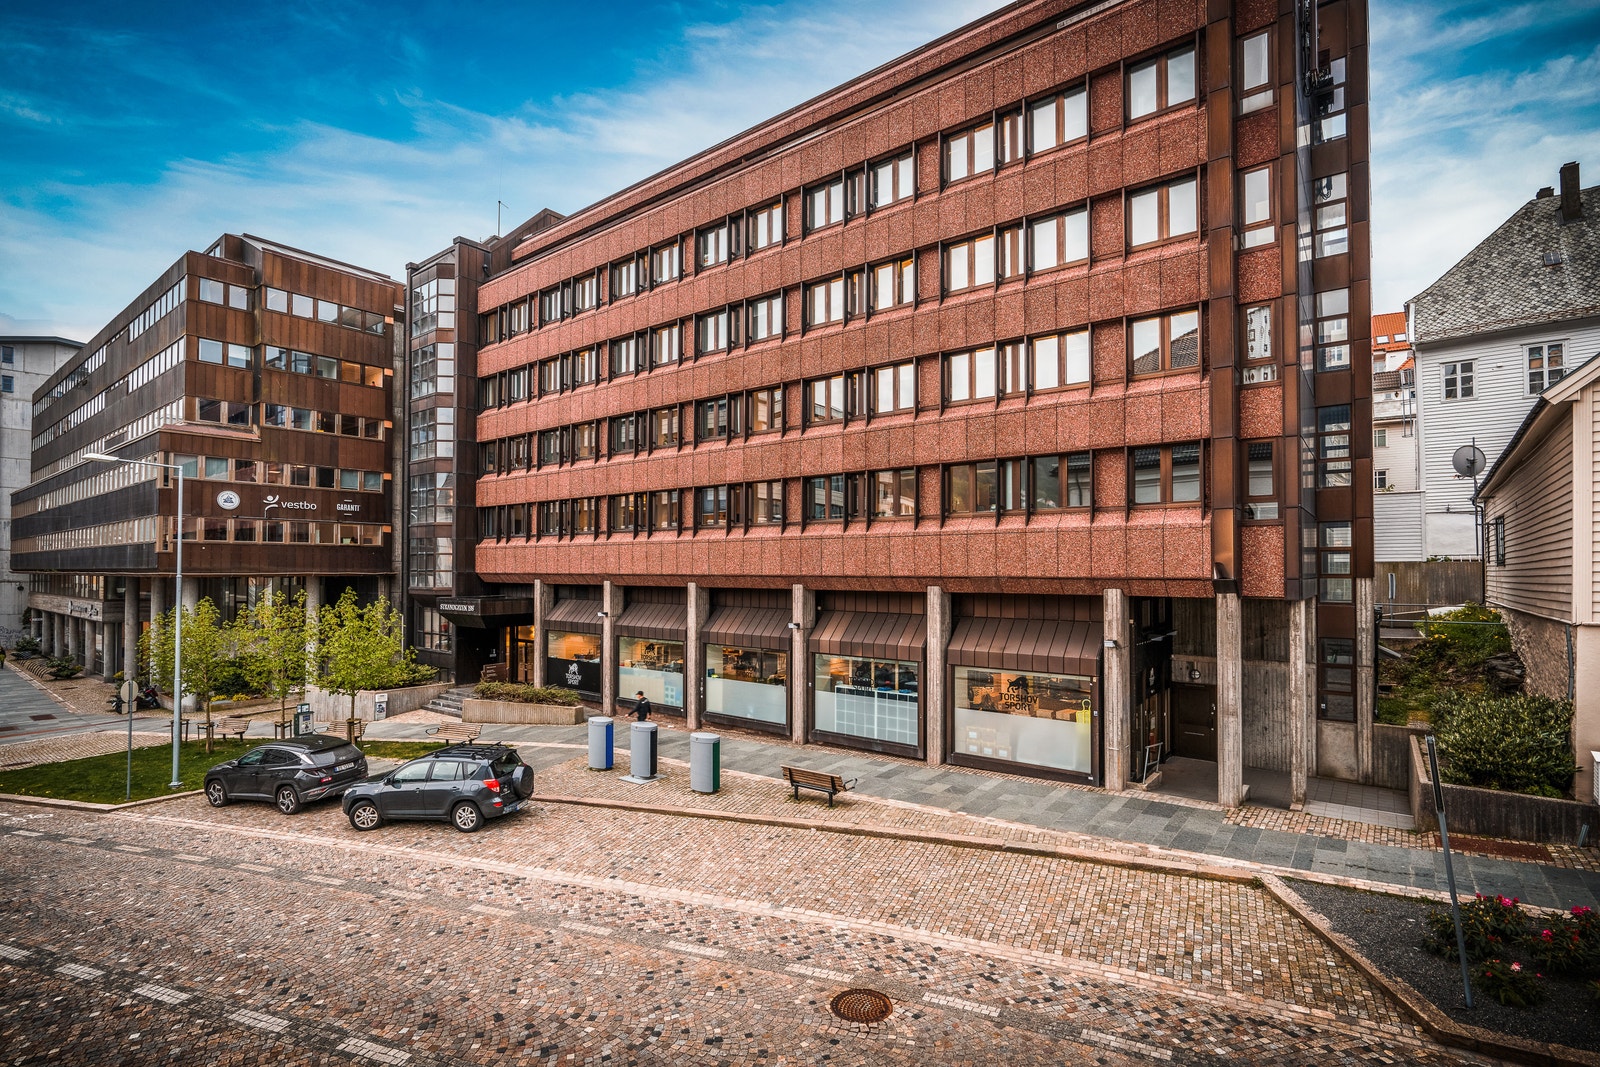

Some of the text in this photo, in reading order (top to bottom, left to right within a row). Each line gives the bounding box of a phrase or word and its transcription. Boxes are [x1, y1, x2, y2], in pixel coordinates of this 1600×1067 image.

[280, 501, 317, 511] vestbo
[336, 503, 360, 512] GARANTI
[998, 692, 1039, 704] TORSHOV
[1004, 701, 1032, 711] SPORT
